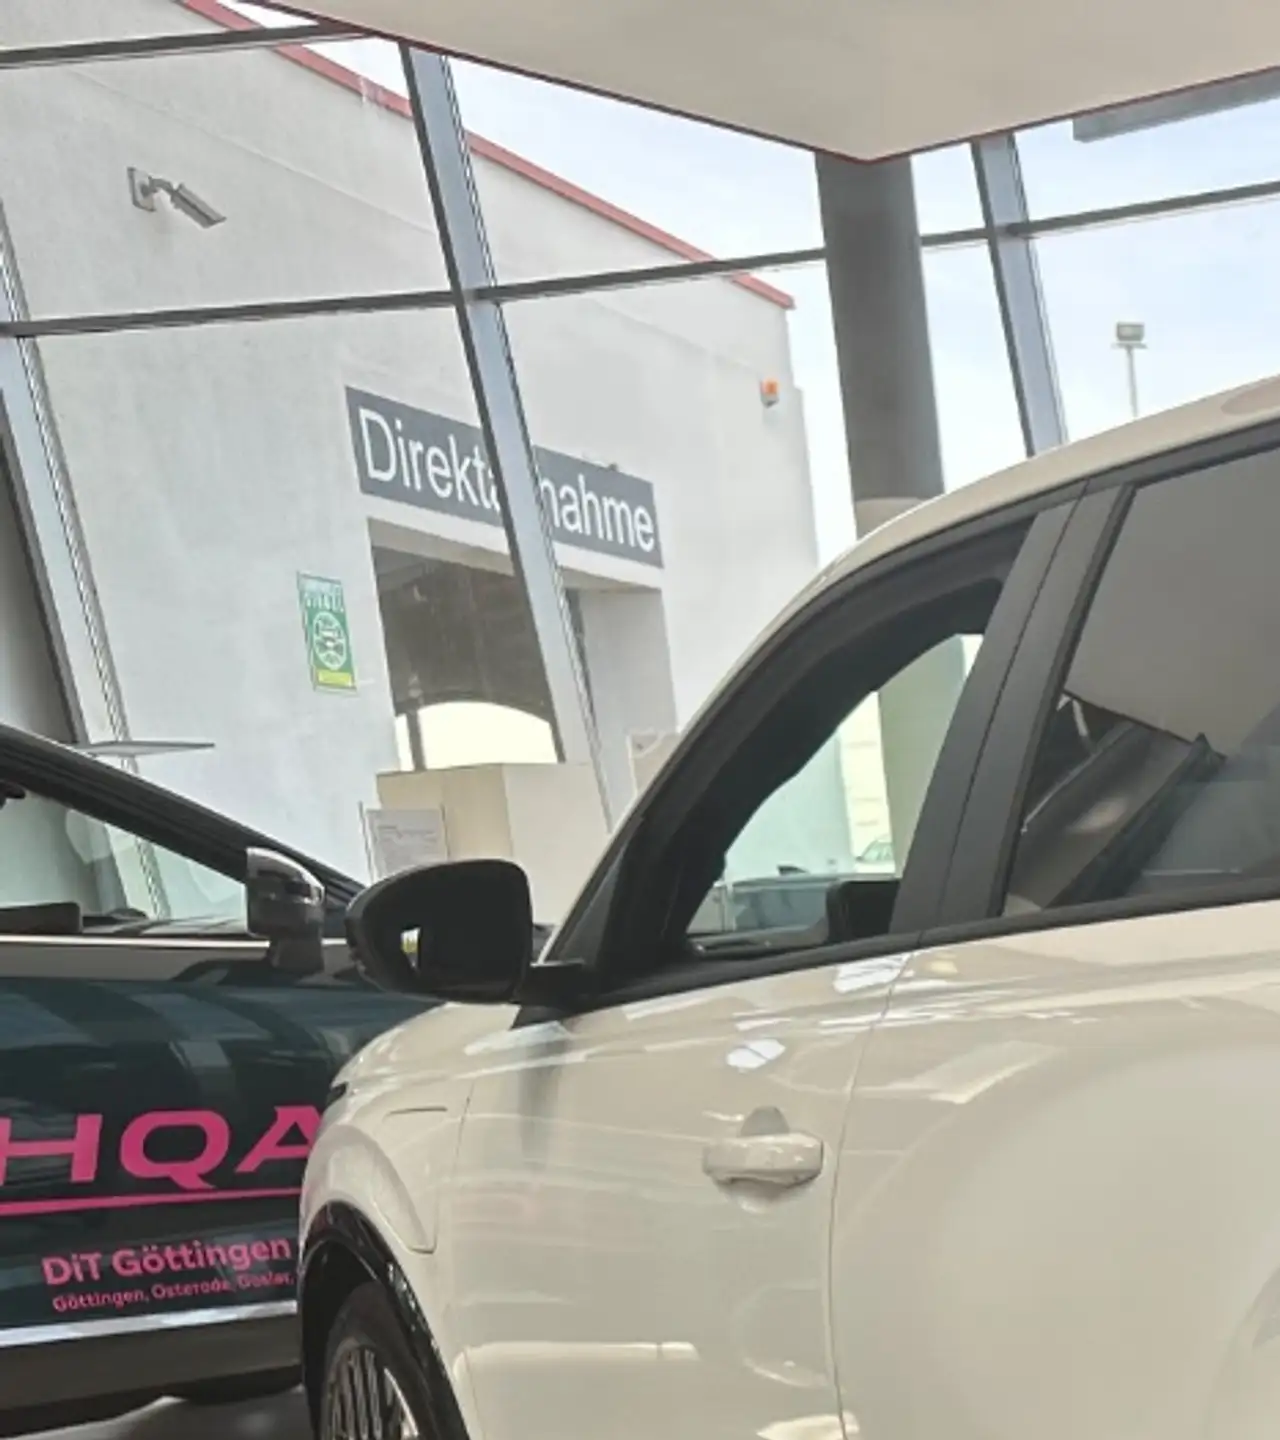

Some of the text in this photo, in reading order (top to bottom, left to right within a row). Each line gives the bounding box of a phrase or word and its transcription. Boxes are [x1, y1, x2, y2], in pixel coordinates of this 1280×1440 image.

[42, 1237, 292, 1284] DiT Göttingen
[52, 1286, 150, 1312] Göttingen,
